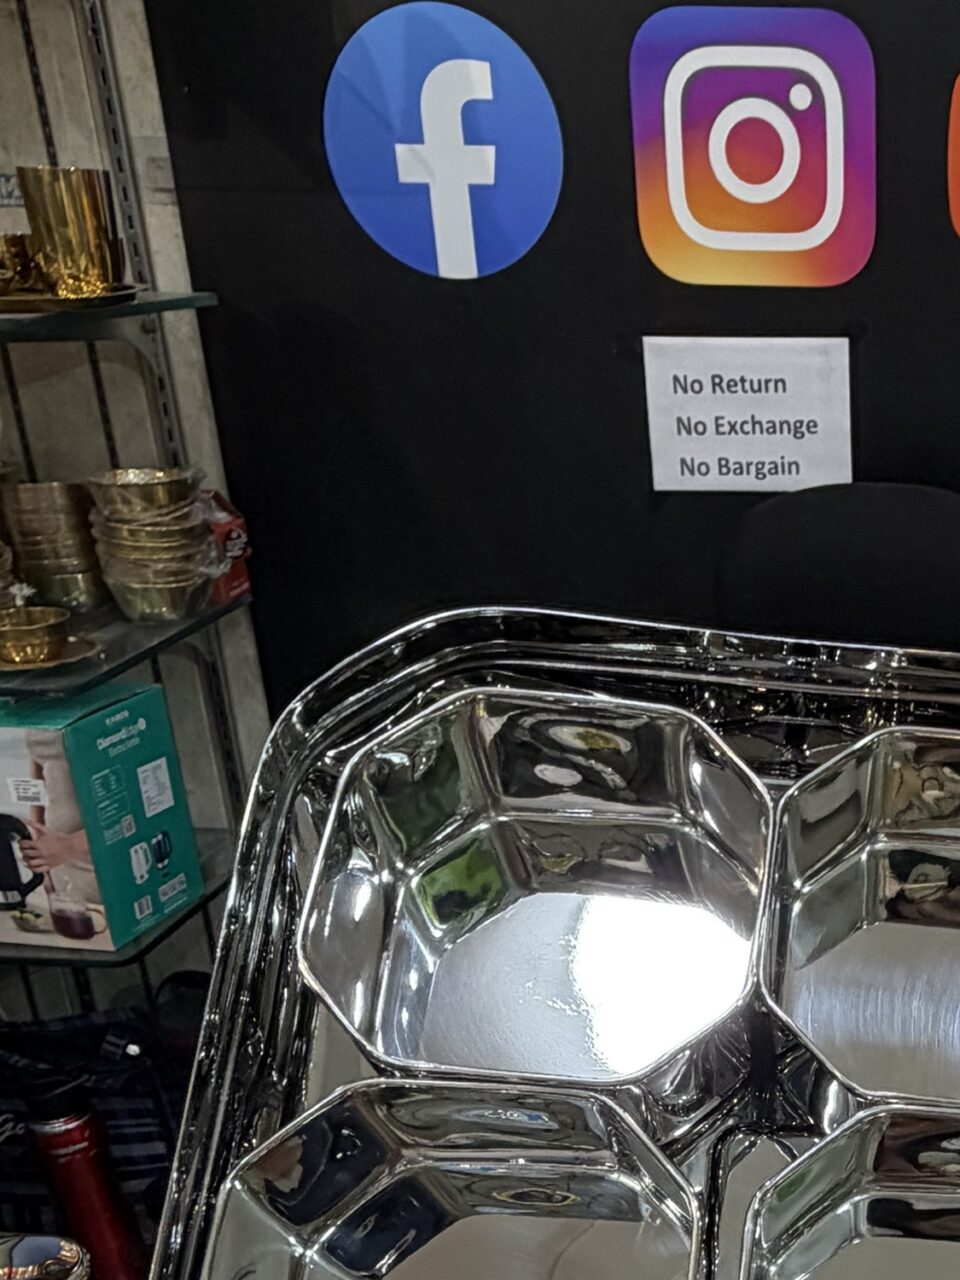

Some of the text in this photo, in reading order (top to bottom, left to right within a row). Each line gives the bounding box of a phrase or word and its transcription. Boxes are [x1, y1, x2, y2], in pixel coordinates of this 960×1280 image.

[672, 374, 787, 394] No Return
[676, 414, 819, 440] No Exchange
[679, 455, 802, 481] No Bargain
